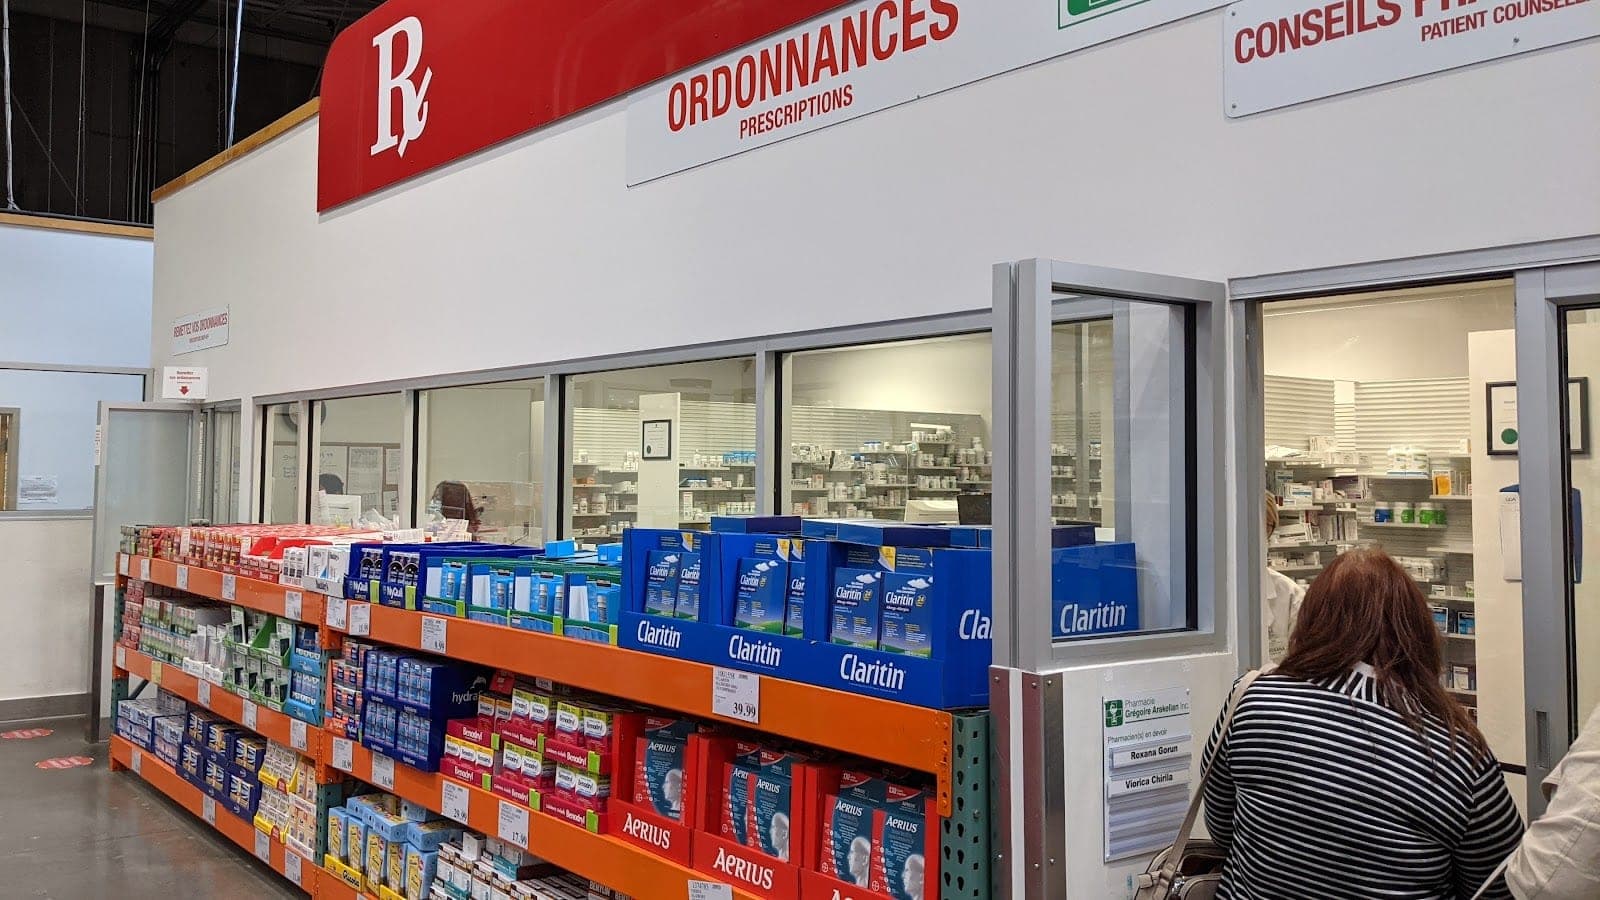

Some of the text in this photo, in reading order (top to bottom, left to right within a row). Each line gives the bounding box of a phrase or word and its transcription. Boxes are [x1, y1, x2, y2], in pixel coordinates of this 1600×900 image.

[1235, 0, 1401, 64] CONSEILS
[1420, 10, 1488, 42] PATIENT
[668, 0, 959, 132] ORDONNANCES
[739, 84, 853, 139] PRESCRIPTIONS
[836, 586, 862, 601] Claritin
[886, 591, 914, 606] Claritin
[959, 609, 992, 640] Cla
[1060, 601, 1126, 633] Claritin
[637, 620, 681, 649] Claritin
[729, 635, 781, 667] Claritin
[840, 653, 905, 690] Claritin
[733, 702, 756, 718] 39.99
[1125, 698, 1155, 708] Pharmacie
[1125, 707, 1151, 718] Grégoire
[462, 727, 483, 741] Benadryl
[1152, 728, 1168, 738] devoir
[567, 752, 587, 766] Benadryl
[1131, 744, 1178, 760] Roxana Gorun
[1125, 777, 1150, 790] Viorica
[566, 810, 585, 825] Benadryl
